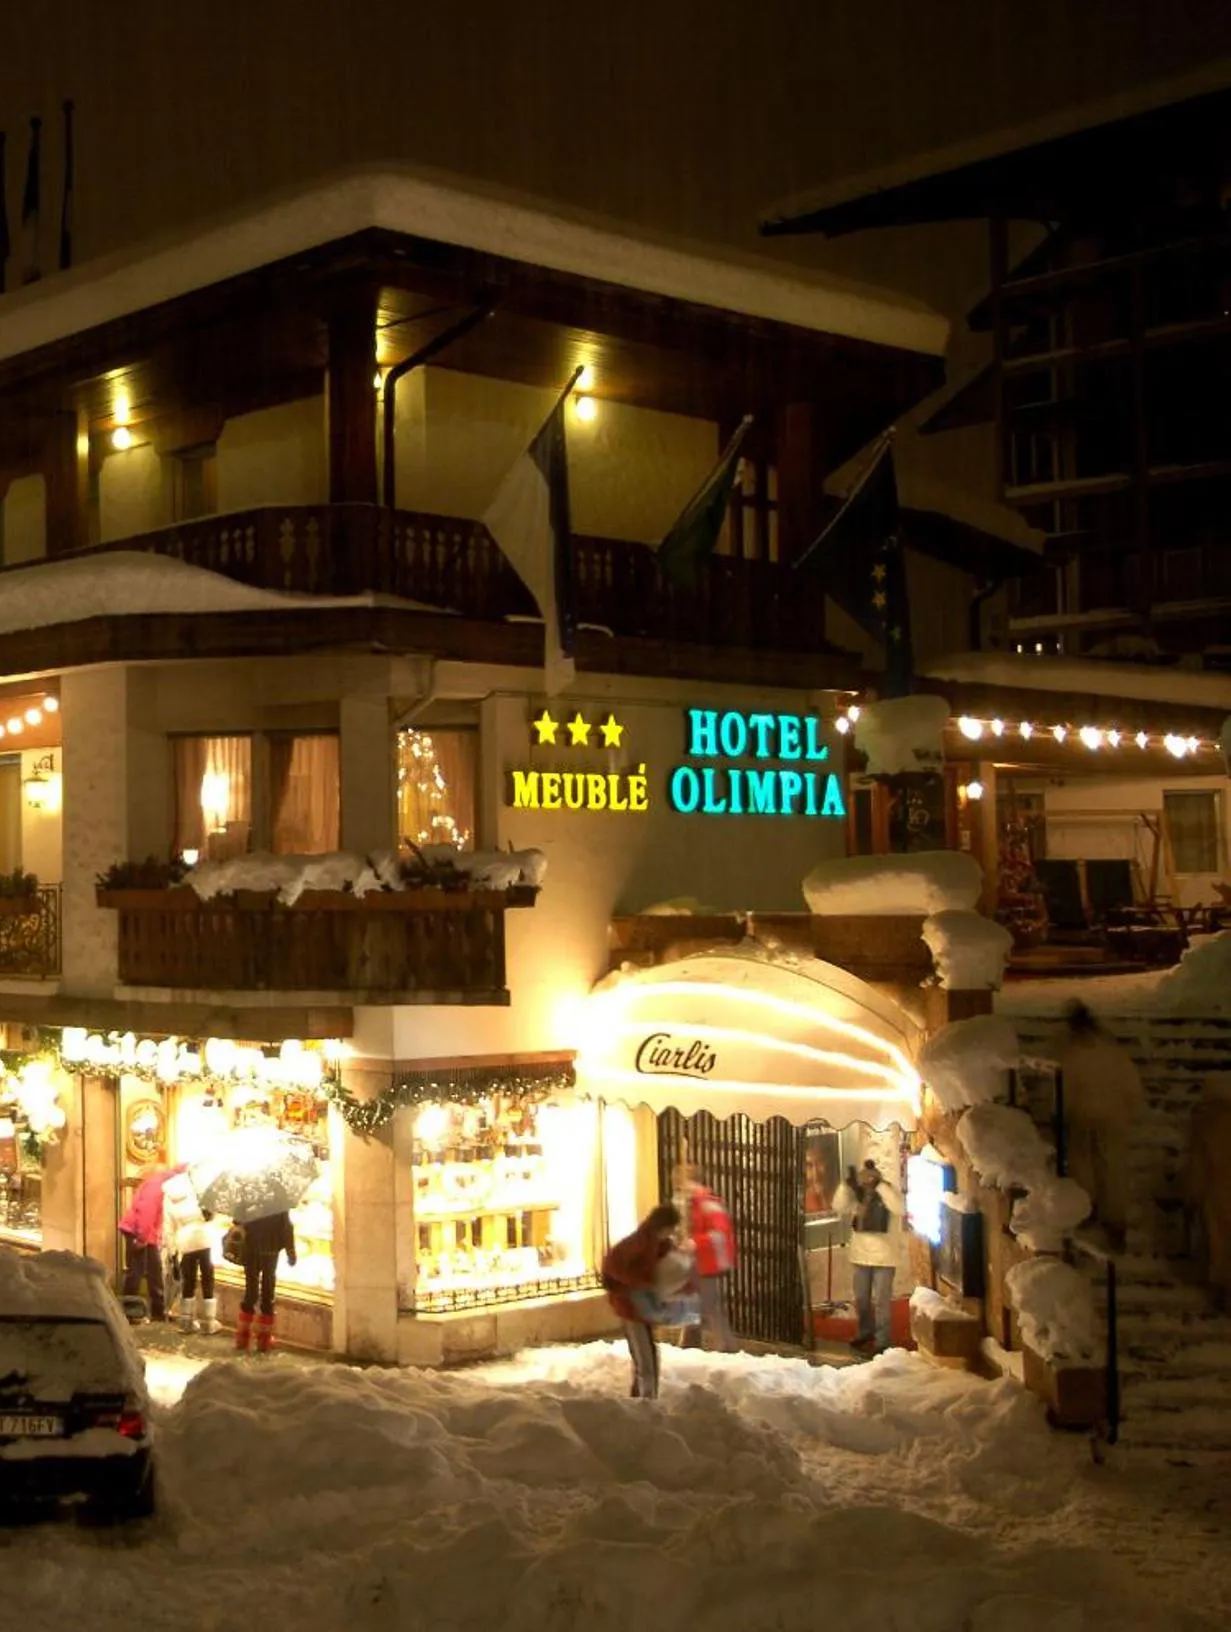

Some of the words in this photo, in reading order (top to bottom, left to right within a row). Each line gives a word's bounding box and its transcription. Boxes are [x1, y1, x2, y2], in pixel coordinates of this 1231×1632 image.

[688, 708, 829, 760] HOTEL
[513, 763, 649, 811] MEUBLÉ
[672, 765, 846, 816] OLIMPIA
